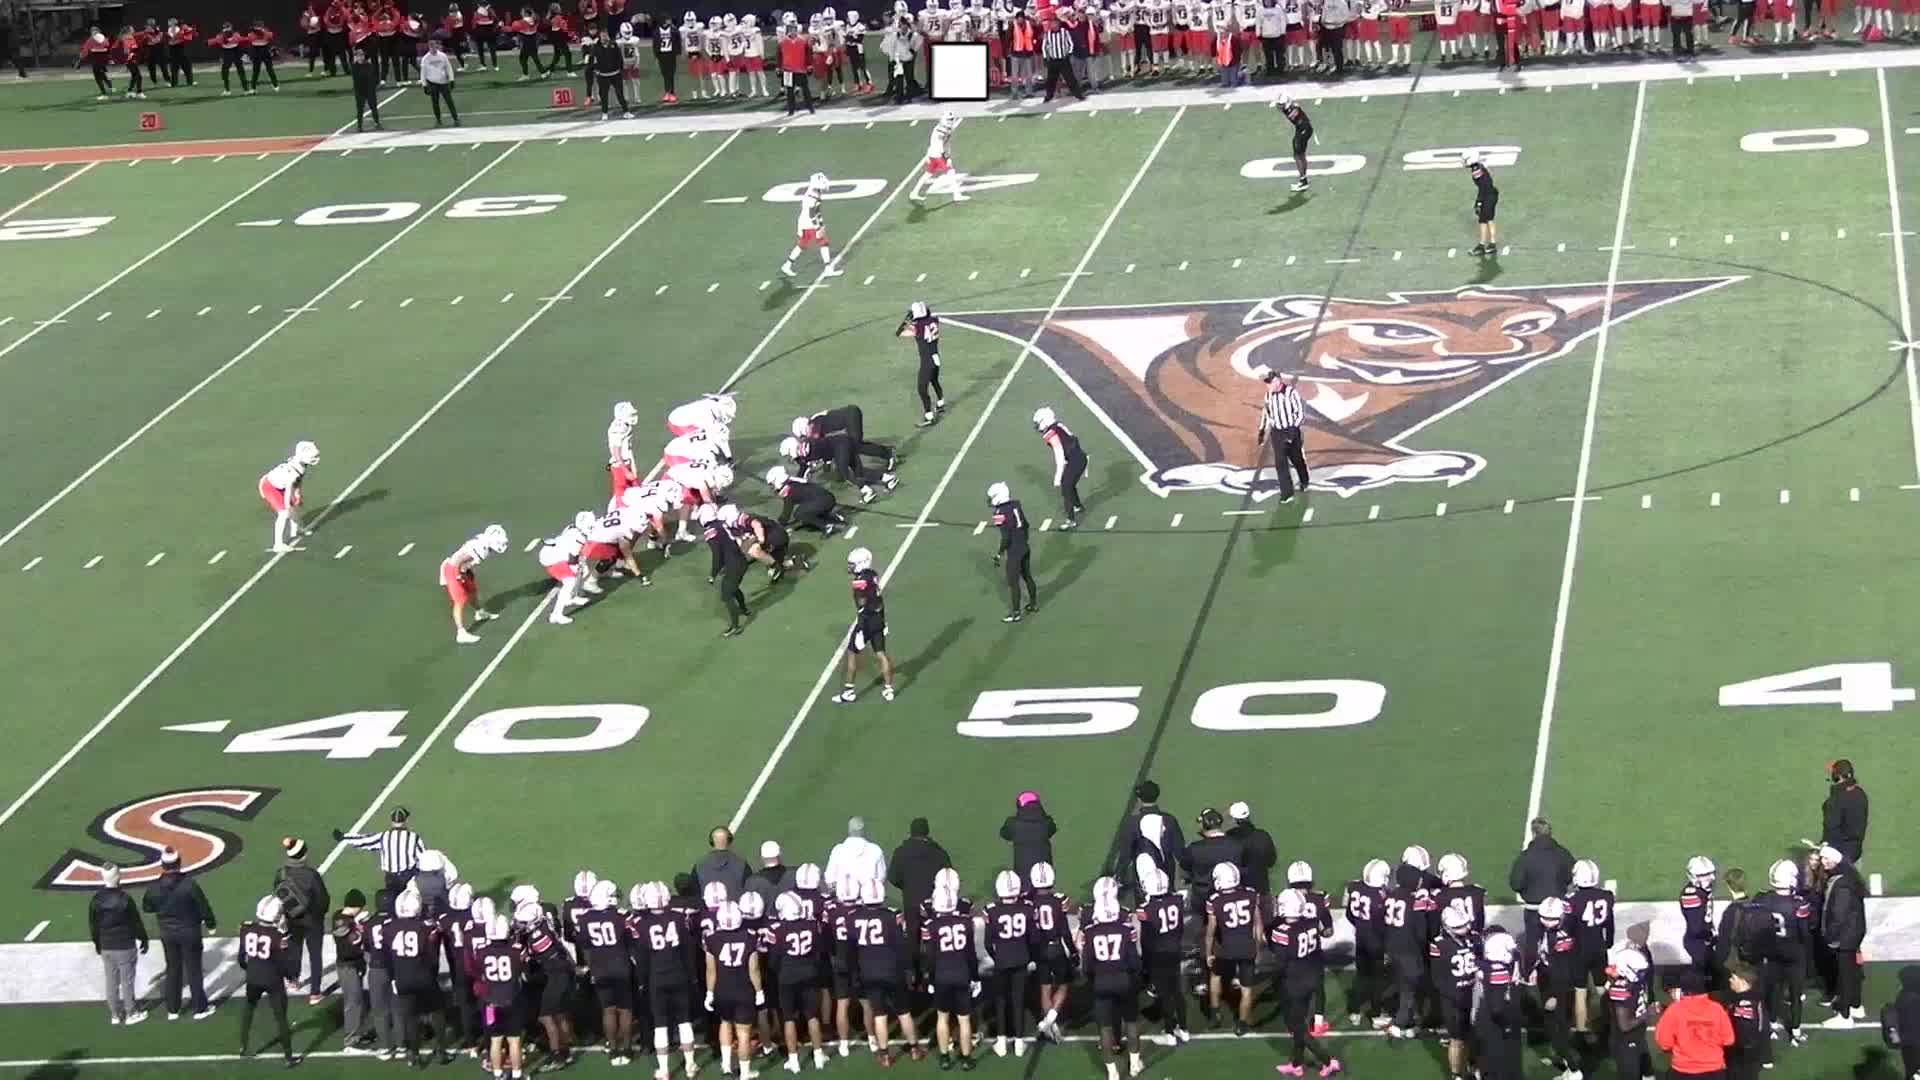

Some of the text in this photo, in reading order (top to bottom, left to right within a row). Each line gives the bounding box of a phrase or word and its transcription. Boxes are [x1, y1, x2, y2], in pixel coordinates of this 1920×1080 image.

[928, 20, 941, 32] 75
[555, 90, 570, 104] 30
[142, 114, 156, 128] 20
[923, 322, 939, 343] 42
[1222, 899, 1251, 929] 35
[1350, 890, 1371, 920] 23
[1384, 898, 1406, 927] 33
[1581, 899, 1608, 927] 43
[854, 918, 885, 945] 72
[998, 912, 1027, 939] 39
[1158, 904, 1179, 934] 19
[244, 932, 272, 960] 83
[391, 930, 419, 957] 49
[588, 921, 617, 946] 50
[650, 921, 680, 950] 64
[785, 929, 813, 956] 32
[938, 923, 967, 952] 26
[1092, 933, 1123, 961] 87
[1297, 927, 1318, 958] 85
[718, 941, 746, 967] 47
[483, 955, 512, 982] 28
